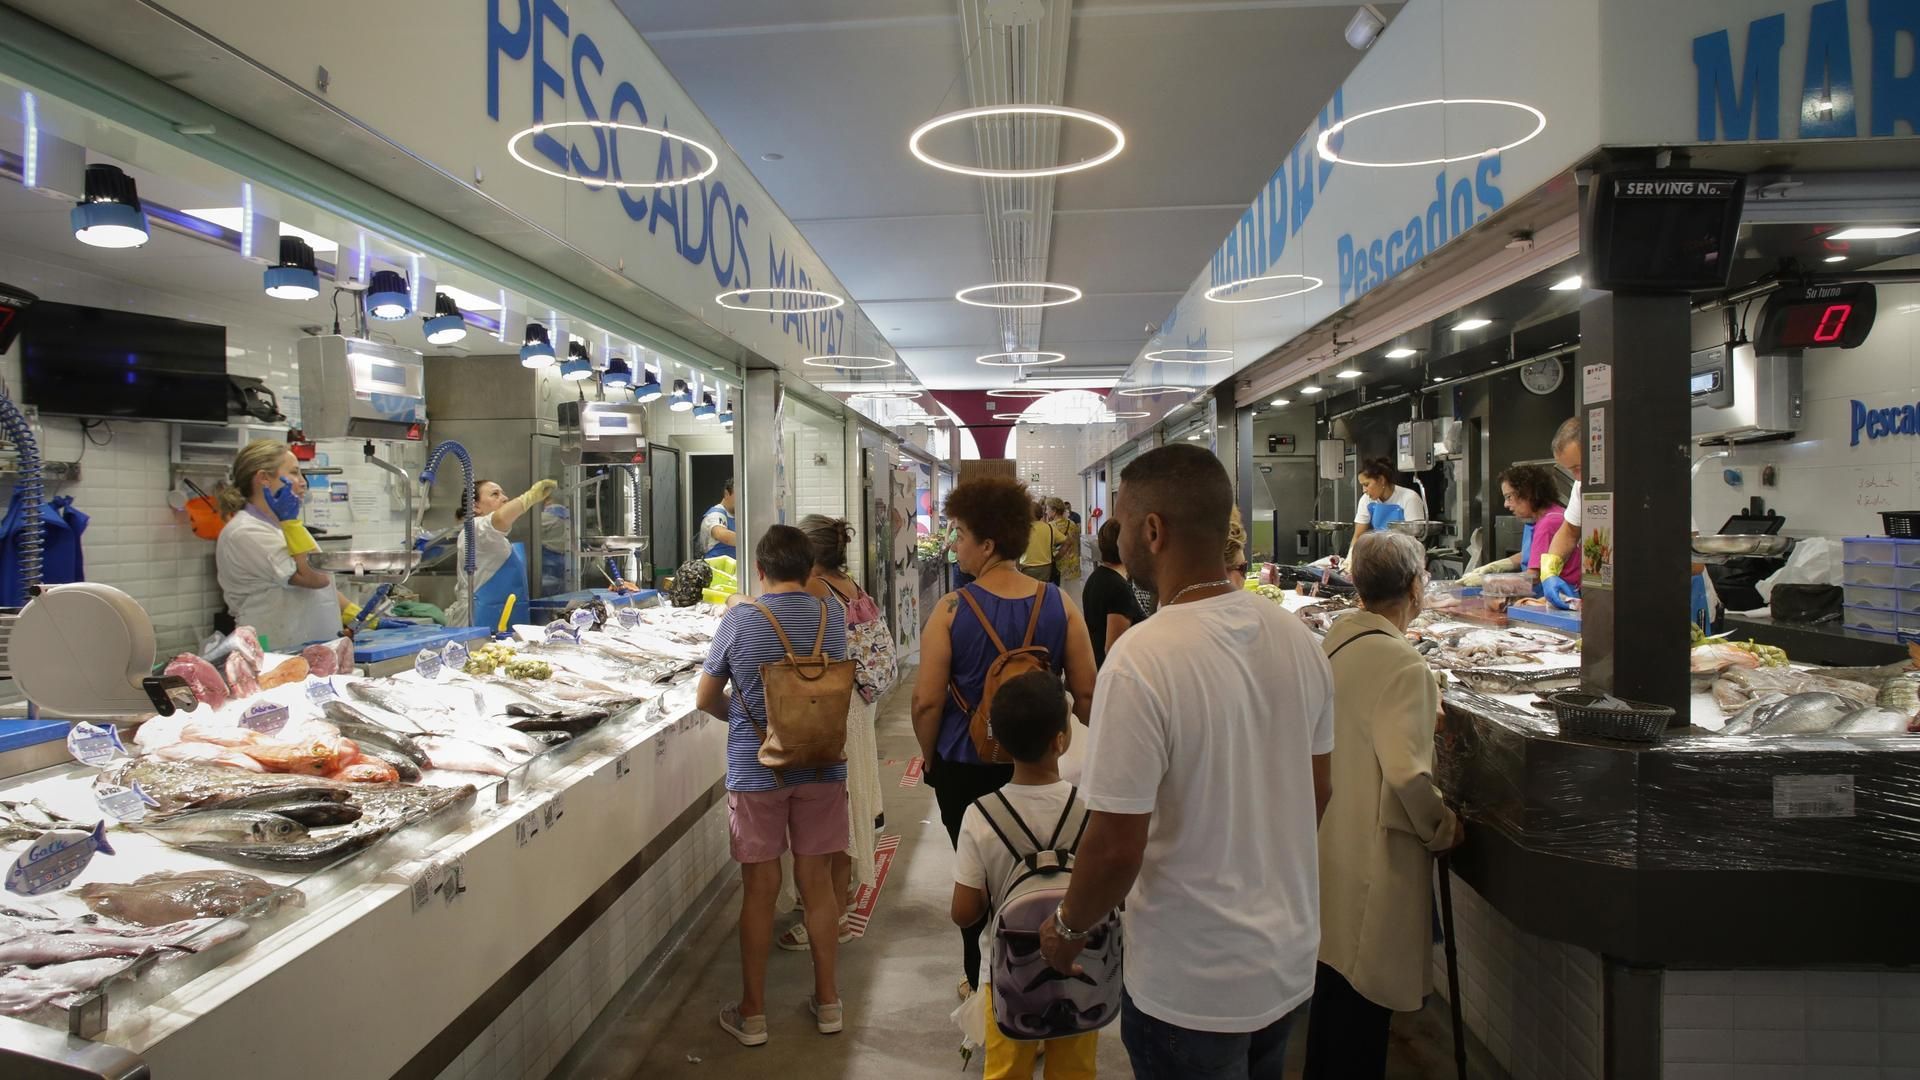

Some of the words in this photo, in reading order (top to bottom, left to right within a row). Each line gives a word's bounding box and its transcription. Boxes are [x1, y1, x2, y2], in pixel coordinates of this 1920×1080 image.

[488, 0, 750, 304] PESCADOS
[1627, 182, 1694, 195] SERVING
[1697, 182, 1720, 195] No.
[1337, 152, 1504, 307] Pescados
[1806, 288, 1818, 299] Su
[1814, 304, 1851, 341] 0
